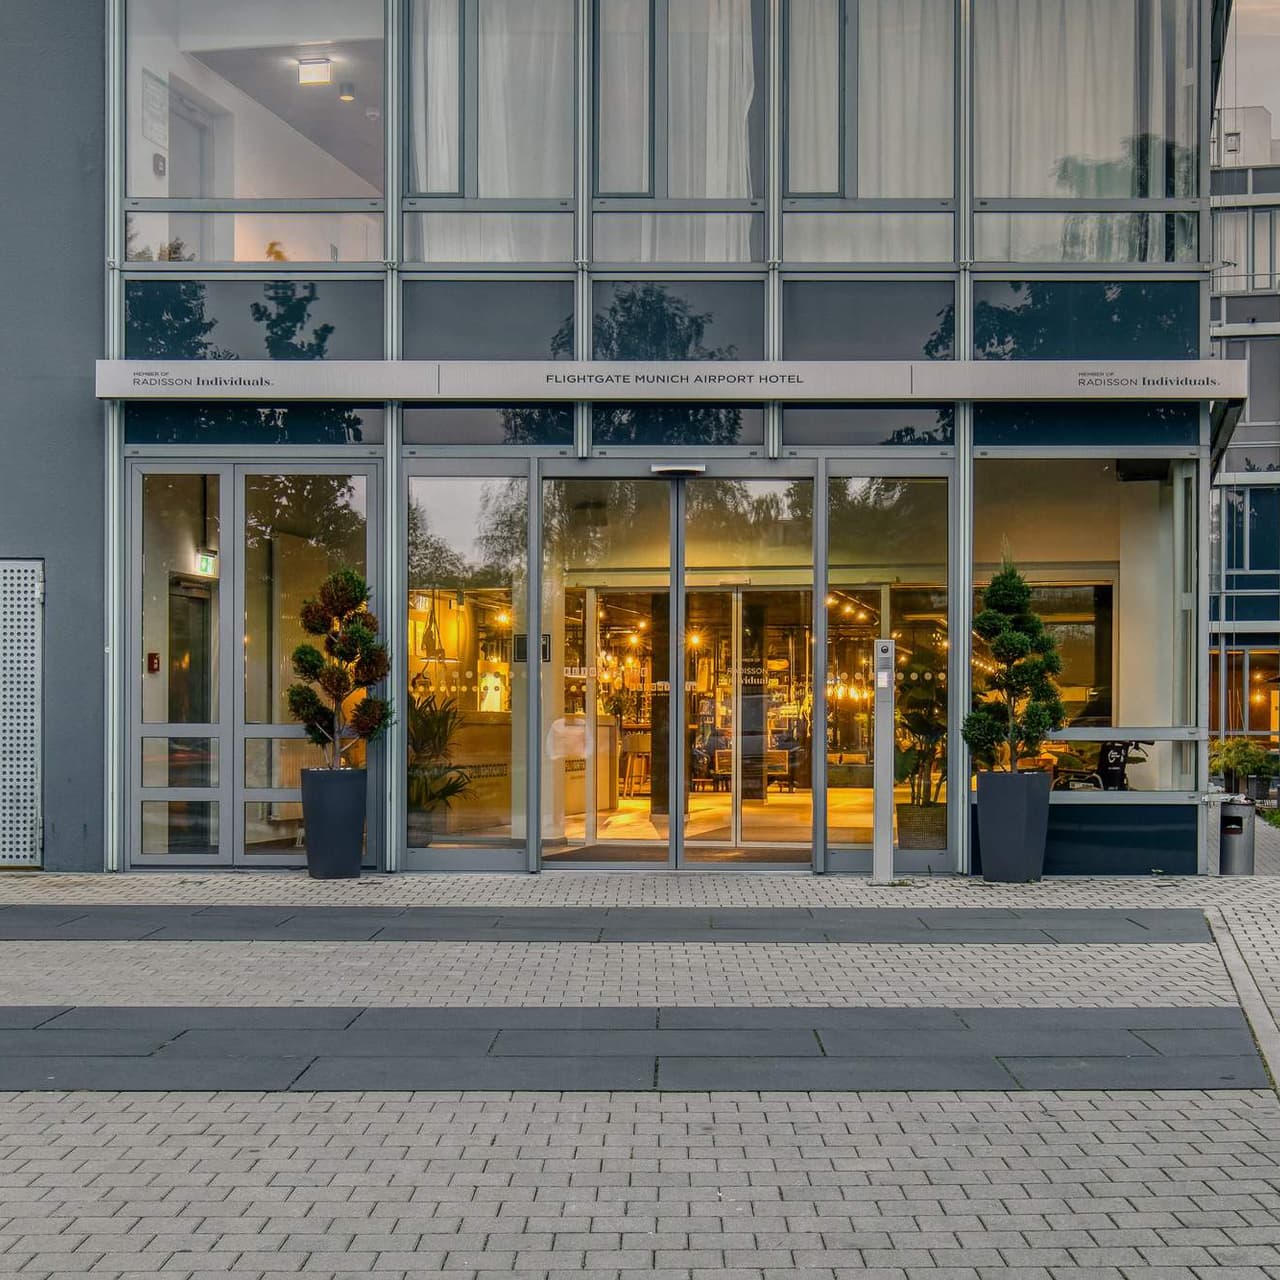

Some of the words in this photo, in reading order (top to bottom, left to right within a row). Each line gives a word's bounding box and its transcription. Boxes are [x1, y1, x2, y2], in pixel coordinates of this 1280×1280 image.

[132, 377, 193, 386] RADISSON
[196, 376, 274, 387] Individuals.
[545, 374, 631, 384] FLIGHTGATE
[635, 374, 689, 384] MUNICH
[693, 374, 754, 384] AIRPORT
[758, 374, 804, 384] HOTEL
[1077, 377, 1139, 387] RADISSON
[1142, 376, 1221, 387] Individuals.
[726, 667, 769, 676] RDISSON
